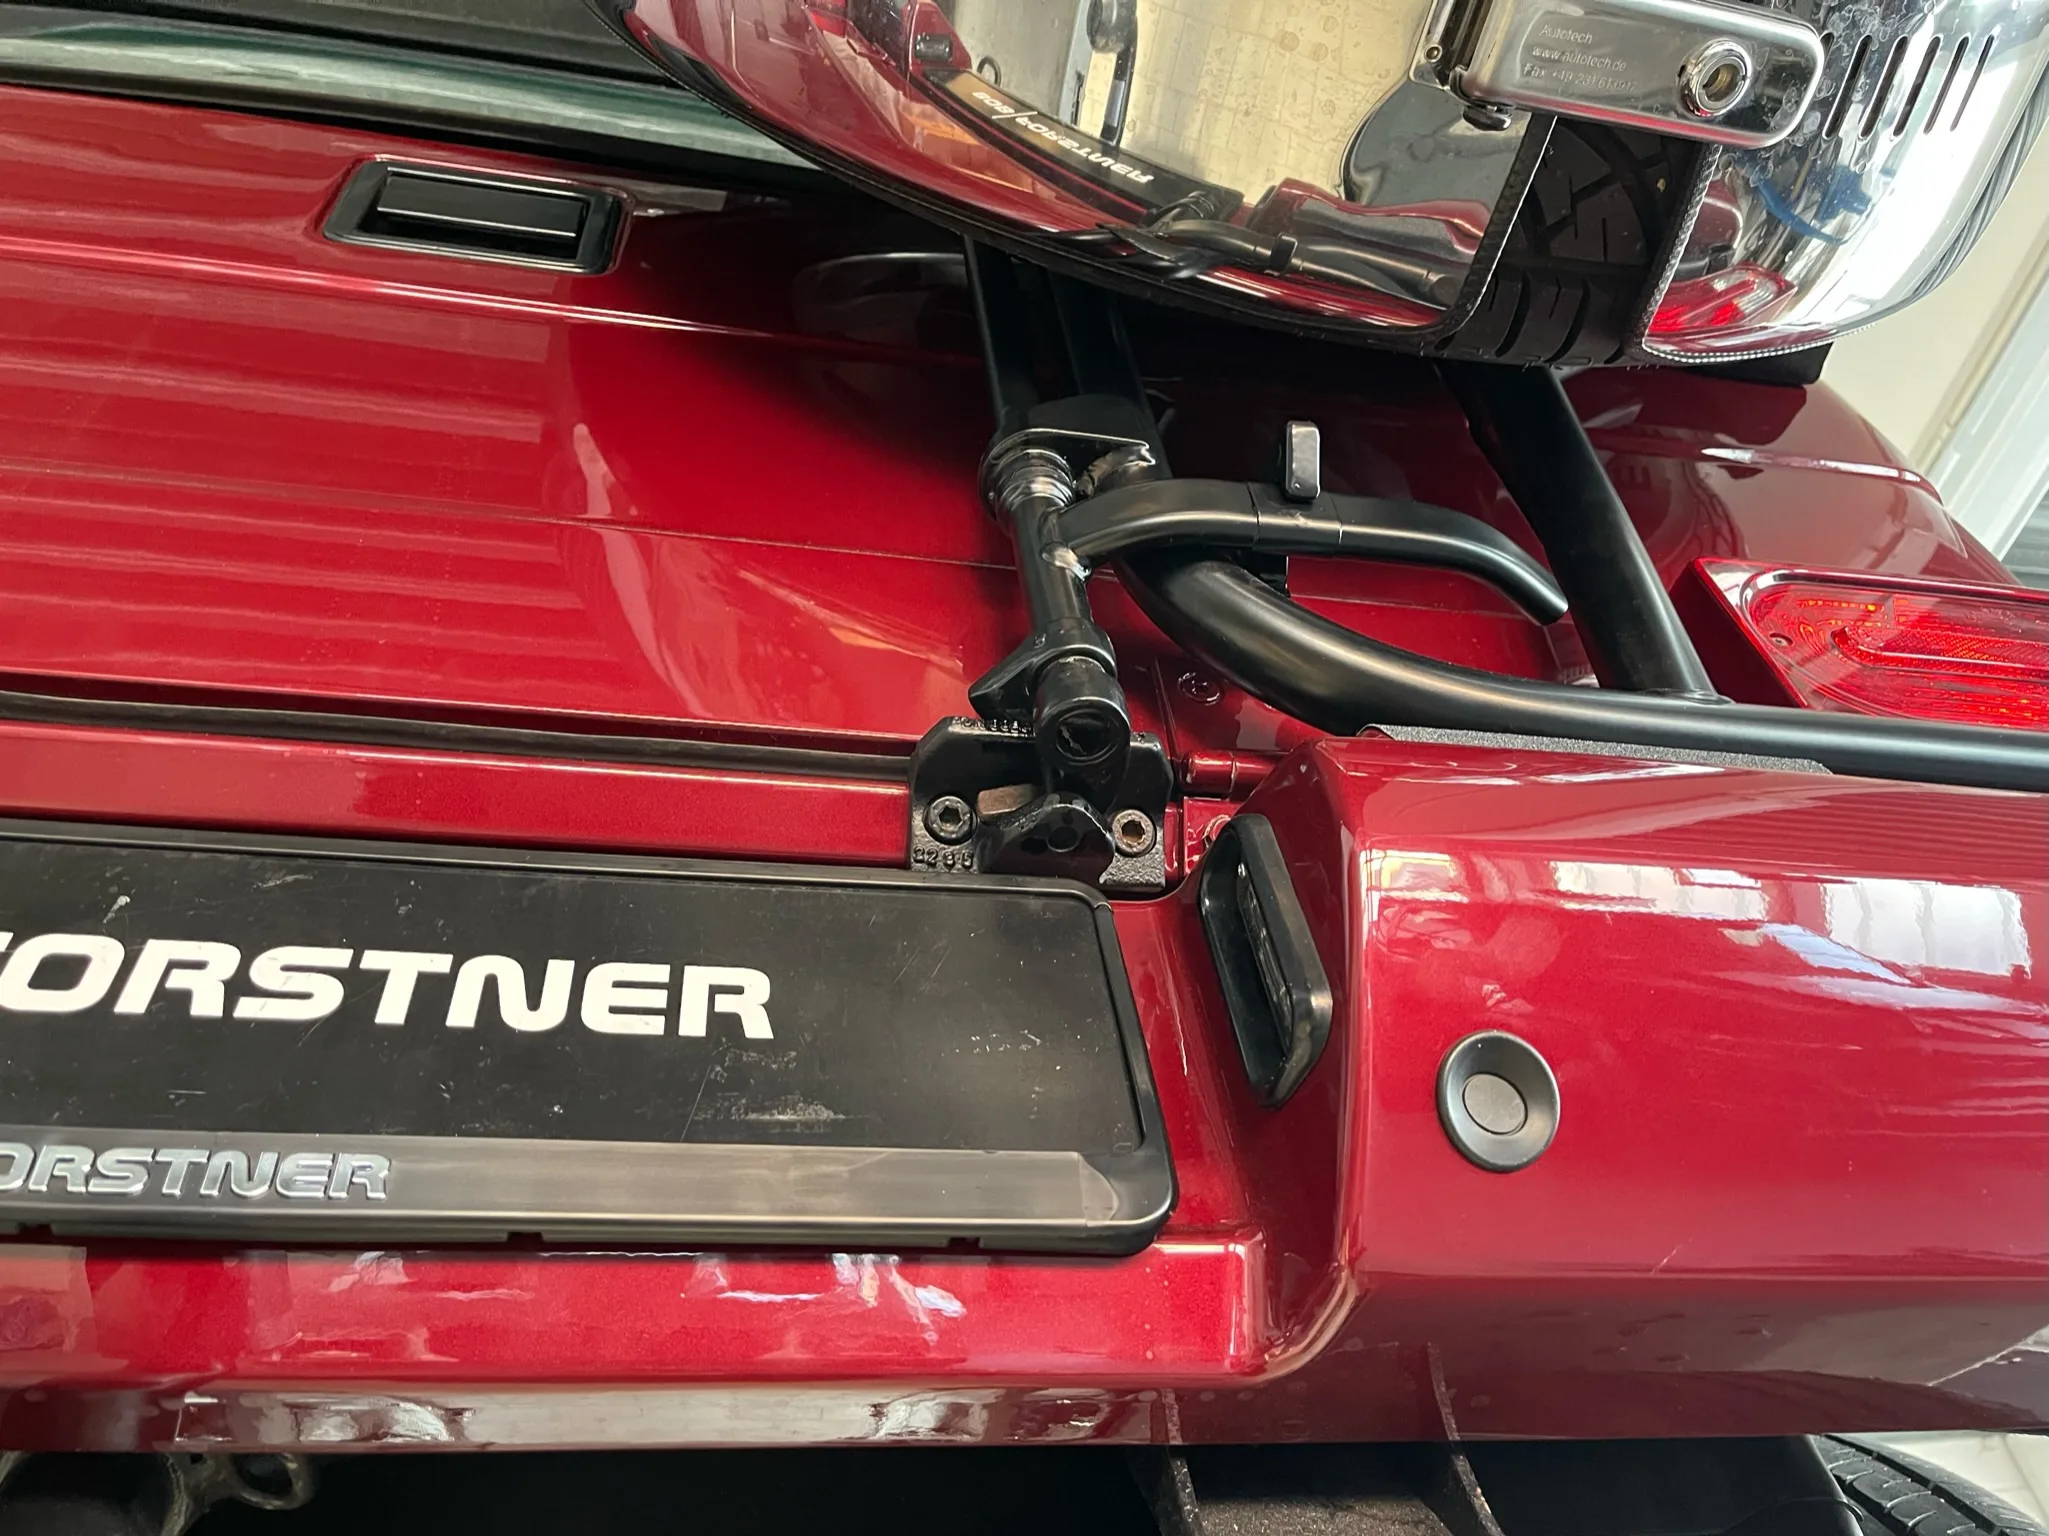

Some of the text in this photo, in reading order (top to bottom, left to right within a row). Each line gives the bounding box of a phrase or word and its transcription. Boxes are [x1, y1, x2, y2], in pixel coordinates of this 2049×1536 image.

[1539, 23, 1593, 44] Autotech
[1523, 62, 1546, 78] Fax
[1532, 46, 1627, 71] www.autotech.de
[0, 931, 774, 1040] ORSTNER
